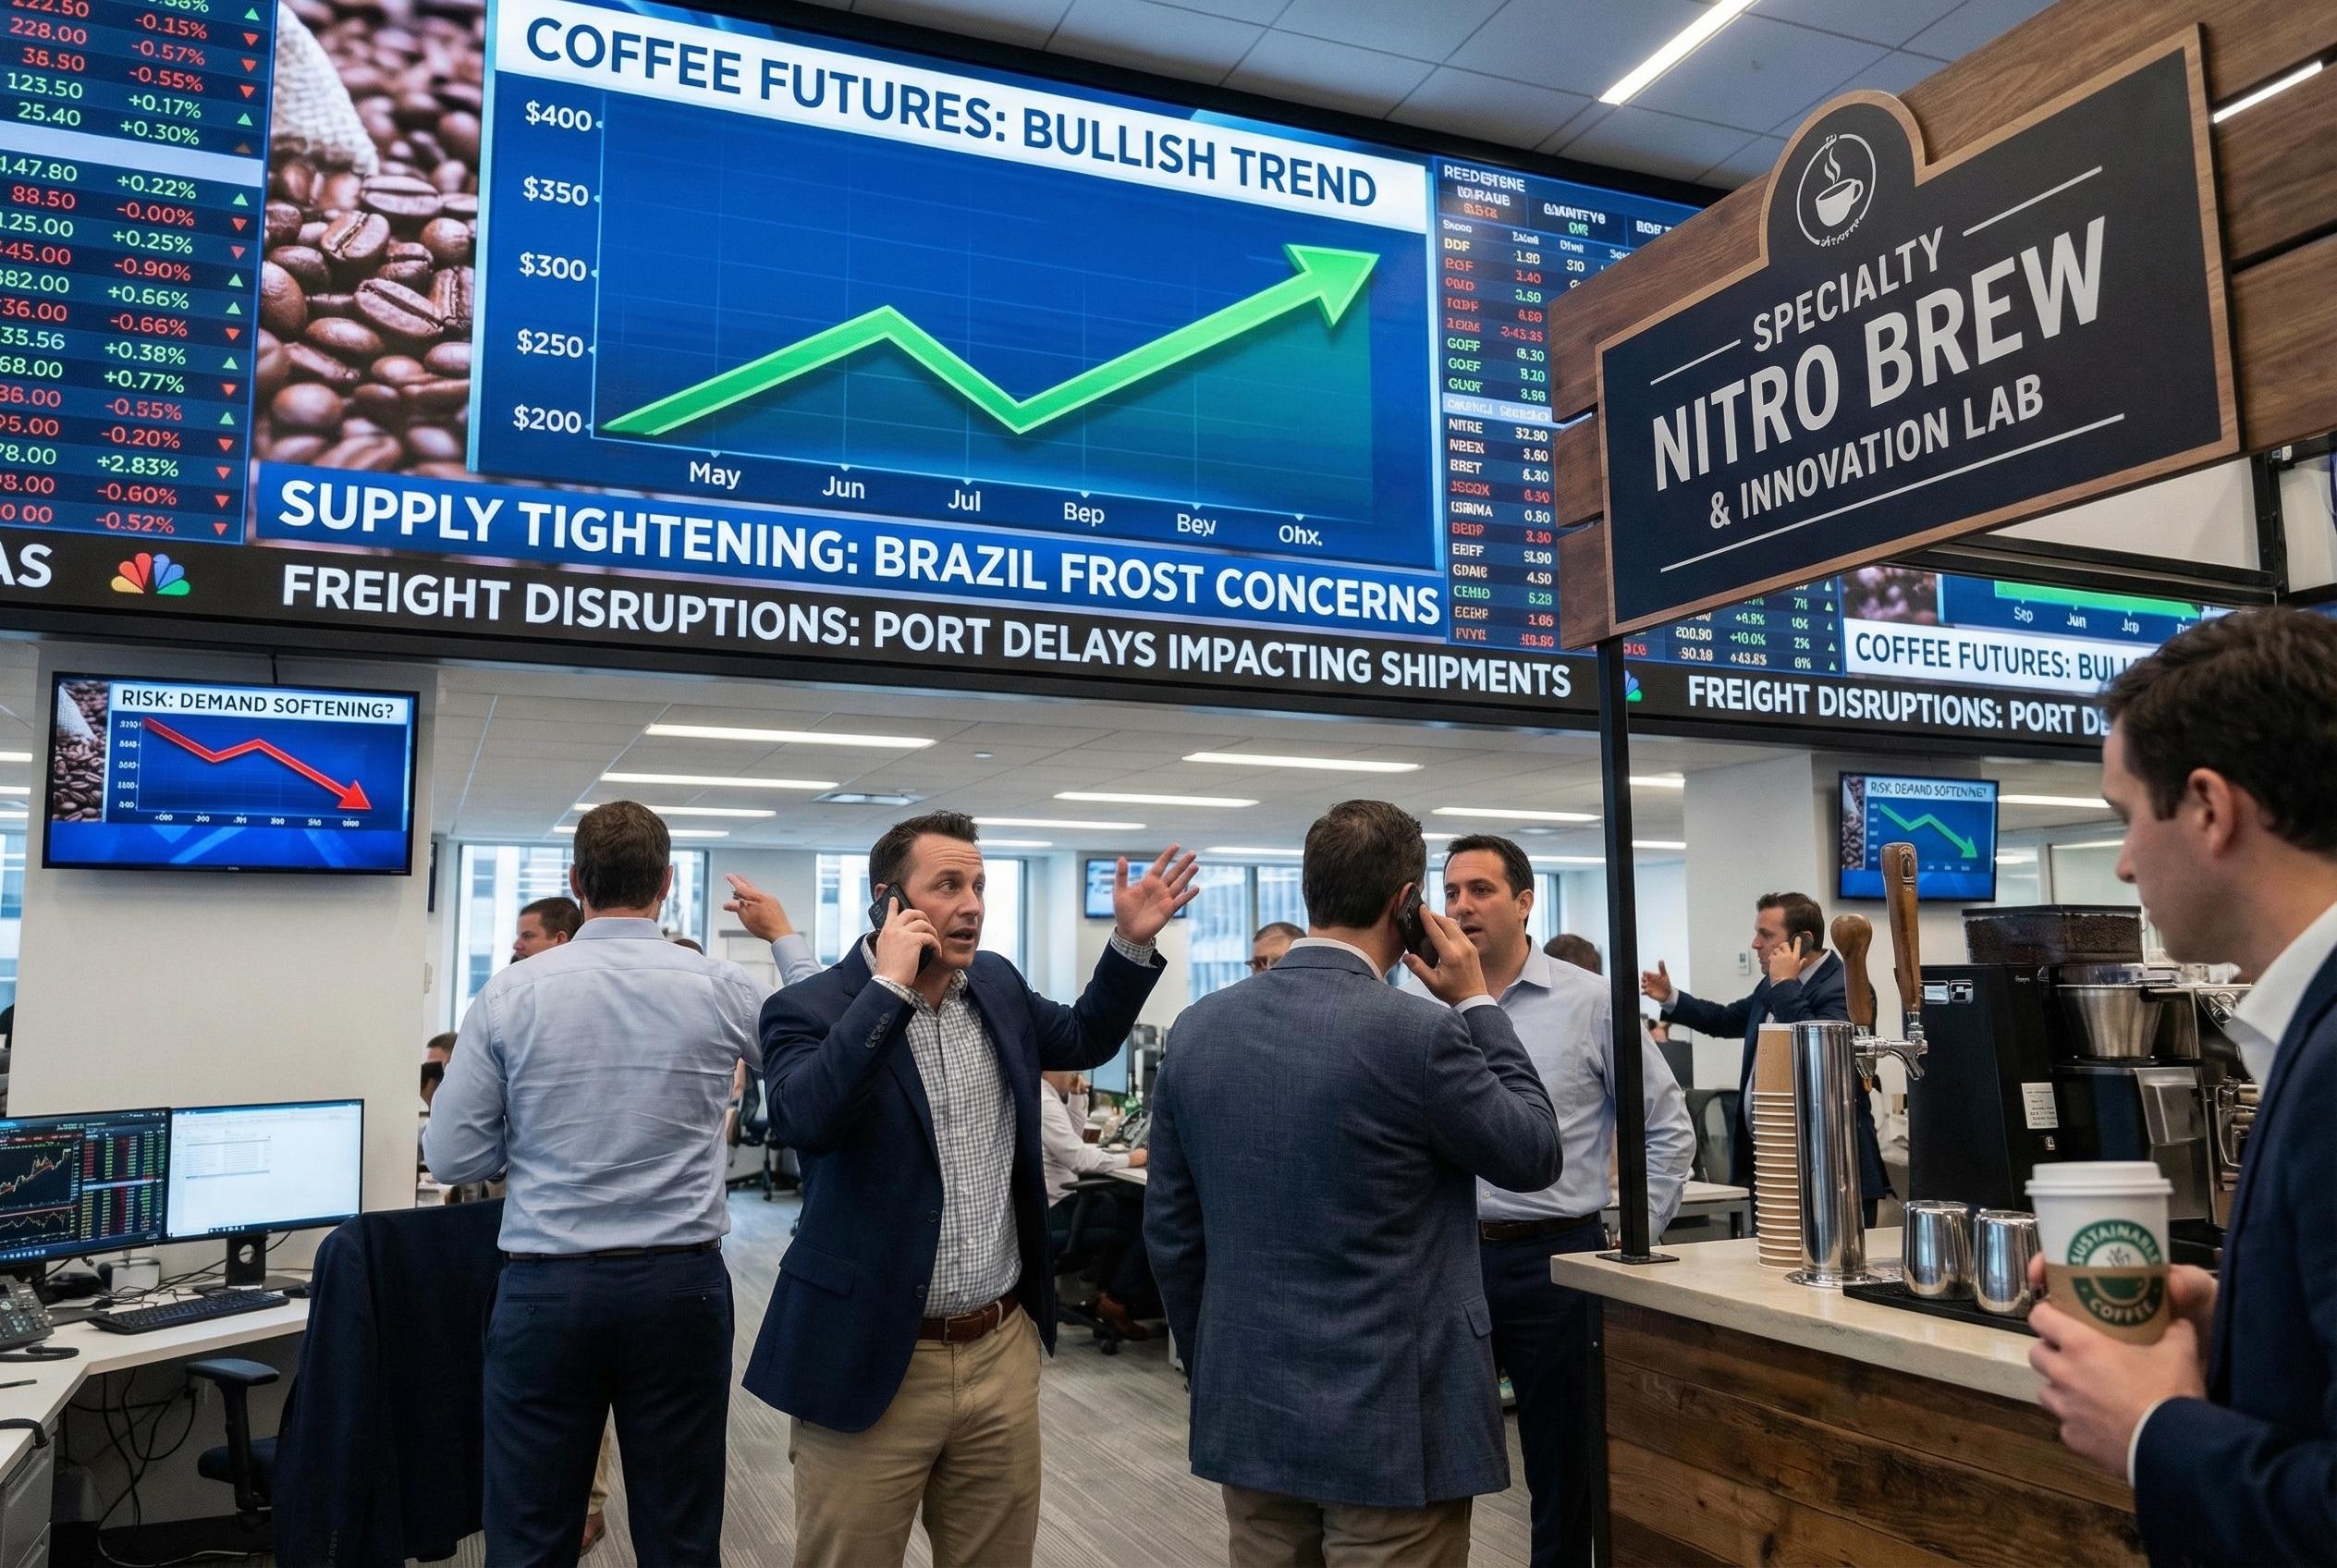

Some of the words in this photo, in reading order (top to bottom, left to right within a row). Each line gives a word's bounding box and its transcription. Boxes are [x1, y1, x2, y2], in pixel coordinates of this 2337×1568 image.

[135, 14, 207, 39] -0.15%
[10, 18, 87, 44] 228.00
[131, 41, 205, 66] -0.57%
[22, 47, 85, 71] 38.50
[128, 67, 203, 92] -0.55%
[7, 72, 82, 99] 123.50
[128, 94, 202, 119] +0.17%
[18, 102, 80, 127] 25.40
[120, 121, 200, 145] +0.30%
[525, 100, 593, 132] $400
[526, 17, 740, 94] COFFEE
[761, 58, 1005, 141] FUTURES:
[1023, 107, 1215, 179] BULLISH
[1231, 146, 1377, 206] TREND
[117, 176, 196, 200] +0.22%
[523, 175, 589, 206] $350
[12, 186, 76, 209] 88.50
[116, 202, 194, 227] -0.00%
[112, 230, 193, 254] +0.25%
[115, 259, 191, 282] -0.90%
[520, 251, 586, 281] $300
[108, 286, 190, 310] +0.66%
[1754, 227, 1944, 352] SPECIALTY
[111, 313, 188, 337] -0.66%
[104, 342, 187, 365] +0.38%
[517, 328, 583, 358] $250
[1652, 344, 1839, 492] NITRO
[1864, 215, 2105, 409] BREW
[104, 371, 185, 394] +0.77%
[513, 404, 581, 432] $200
[102, 426, 180, 449] -0.20%
[1709, 492, 1731, 530] &
[1742, 408, 1949, 520] INNOVATION
[1964, 374, 2044, 440] LAB
[97, 456, 178, 478] +2.83%
[97, 483, 177, 506] -0.60%
[690, 461, 740, 489] May
[823, 475, 864, 499] Jun
[948, 488, 981, 511] Jul
[1064, 502, 1105, 527] Bep
[96, 511, 175, 534] -0.52%
[278, 480, 504, 542] SUPPLY
[519, 501, 858, 574] TIGHTENING:
[874, 536, 1046, 591] BRAZIL
[1061, 553, 1204, 603] FROST
[1216, 568, 1440, 626] CONCERNS
[283, 564, 510, 621] FREIGHT
[525, 582, 861, 646] DISRUPTIONS:
[874, 611, 990, 655] PORT
[1001, 621, 1156, 668] DELAYS
[1168, 633, 1371, 683] IMPACTING
[1381, 649, 1572, 698] SHIPMENTS
[1855, 632, 1951, 668] COFFEE
[1959, 642, 2071, 679] FUTURES:
[122, 690, 174, 708] RISK:
[179, 692, 266, 712] DEMAND
[274, 697, 394, 718] SOFTENING?
[1688, 675, 1810, 714] FREIGHT
[1818, 685, 2003, 729] DISRUPTIONS:
[2011, 700, 2076, 734] PORT
